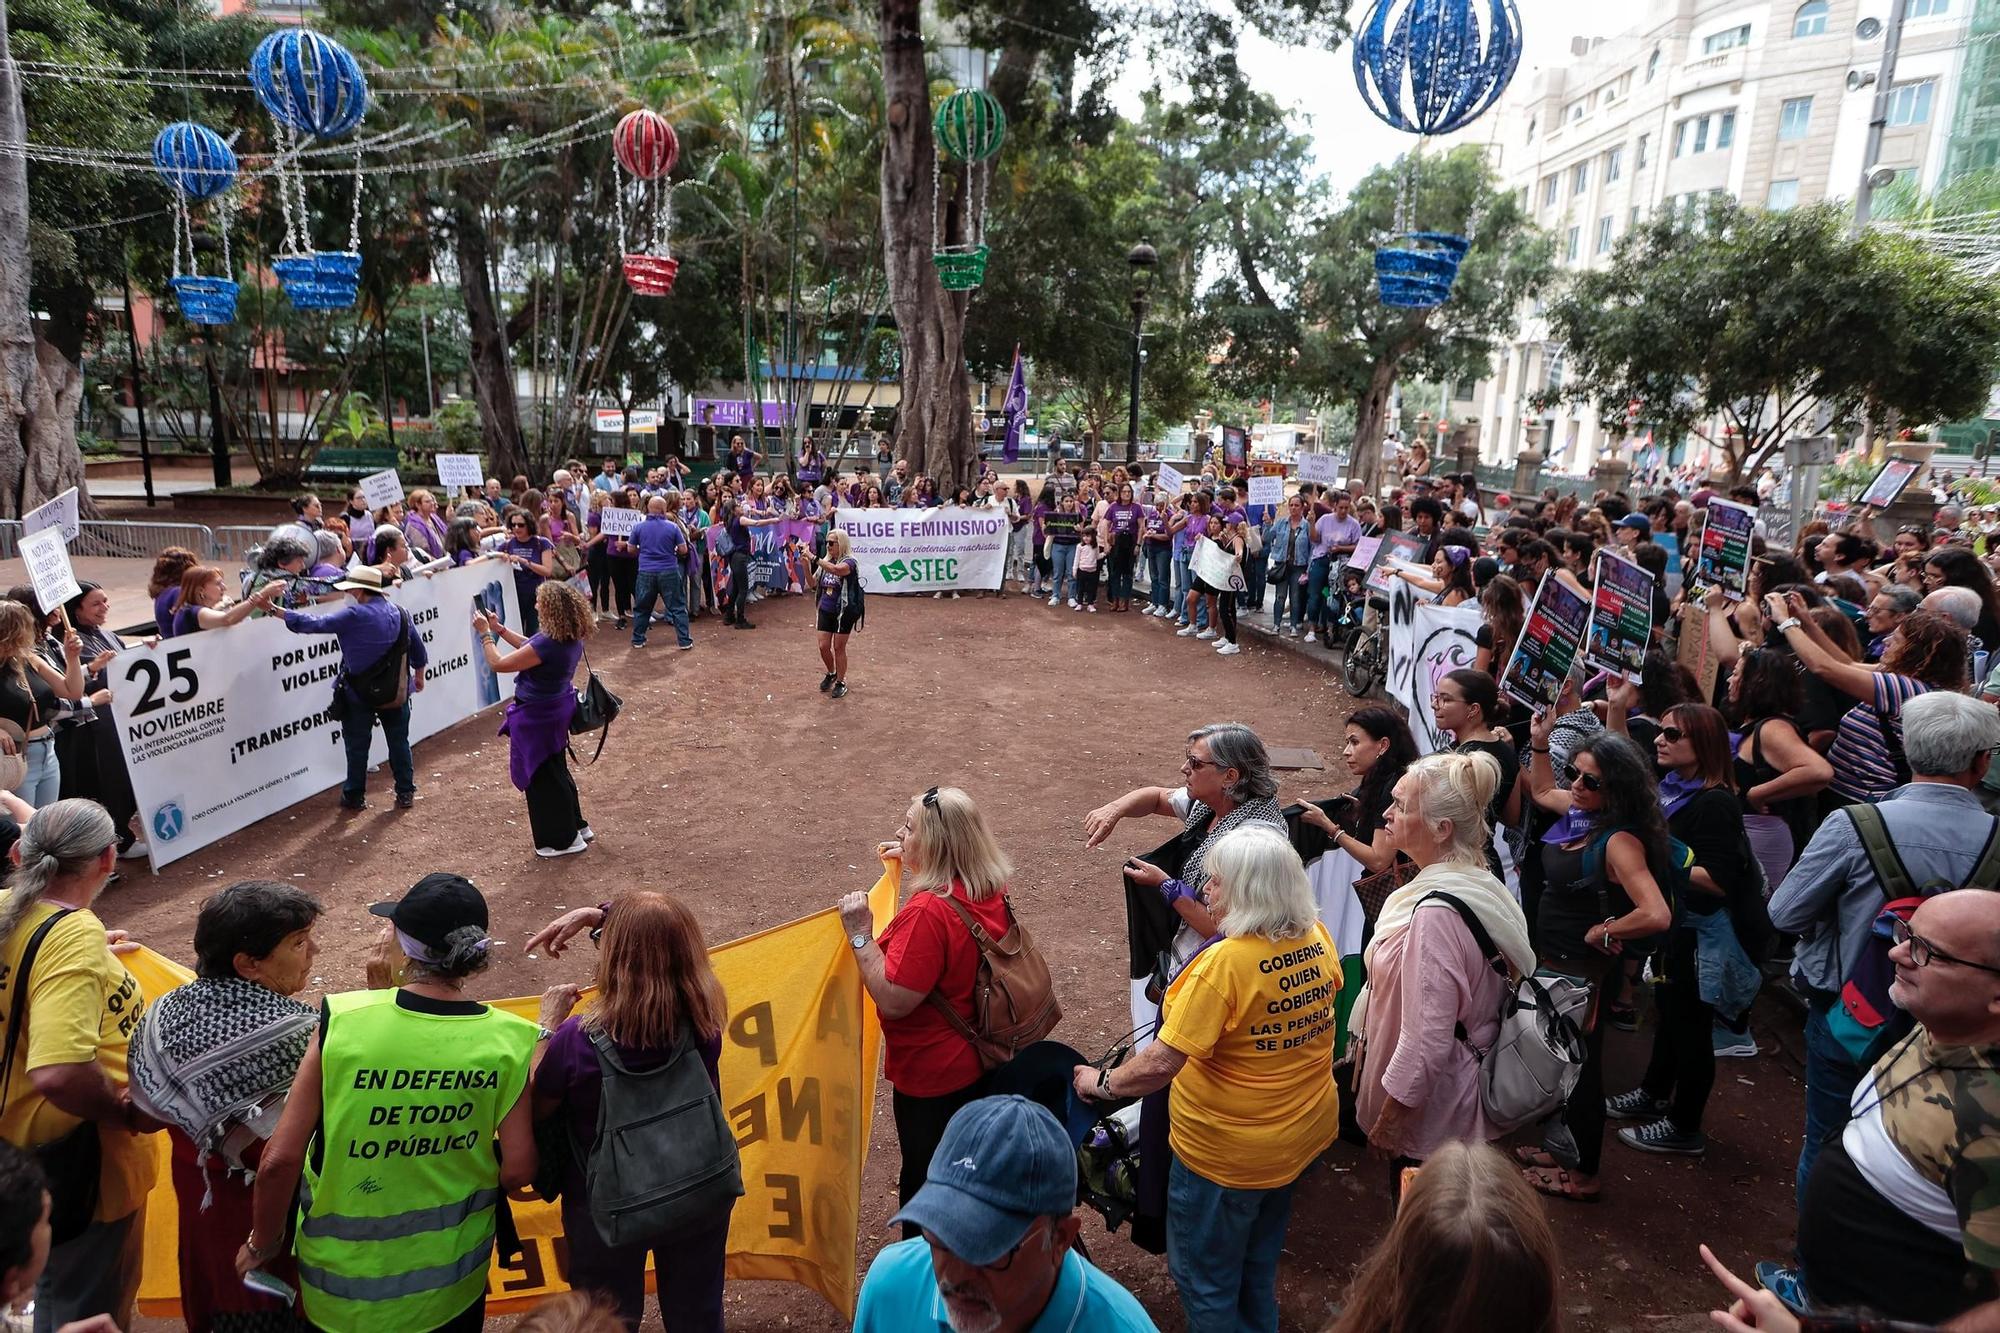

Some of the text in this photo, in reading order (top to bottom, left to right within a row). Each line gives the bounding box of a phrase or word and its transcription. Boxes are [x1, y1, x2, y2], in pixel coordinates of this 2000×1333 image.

[1310, 455, 1328, 463] VIVAS
[38, 500, 64, 520] VIVAS
[604, 510, 638, 521] NI UNA
[602, 520, 632, 532] MENO
[870, 546, 896, 554] contra
[898, 545, 912, 554] las
[912, 544, 956, 553] violencias
[958, 543, 1000, 552] machistas
[33, 554, 62, 576] VIOLENCIA
[910, 558, 958, 582] STEC
[426, 606, 439, 622] DE
[272, 638, 340, 671] POR UNA
[425, 654, 468, 681] OLÍTICAS
[125, 648, 199, 718] 25
[282, 662, 340, 692] VIOLEN
[128, 697, 224, 742] NOVIEMBRE
[144, 726, 198, 750] INTERNACIONAL
[200, 716, 226, 730] CONTRA
[132, 726, 224, 764] LAS VIOLENCIAS MACHISTAS
[192, 812, 206, 822] FORO
[206, 802, 227, 814] CONTRA
[234, 788, 258, 802] VIOLENCIA
[1259, 942, 1324, 974] GOBIERNE
[1279, 965, 1321, 992] QUIEN
[1250, 1007, 1330, 1036] LAS PENSIO
[1256, 1040, 1277, 1051] SE
[354, 1069, 498, 1090] EN DEFENSA
[368, 1102, 474, 1126] DE TODO
[348, 1130, 479, 1160] LO PÚBLICO
